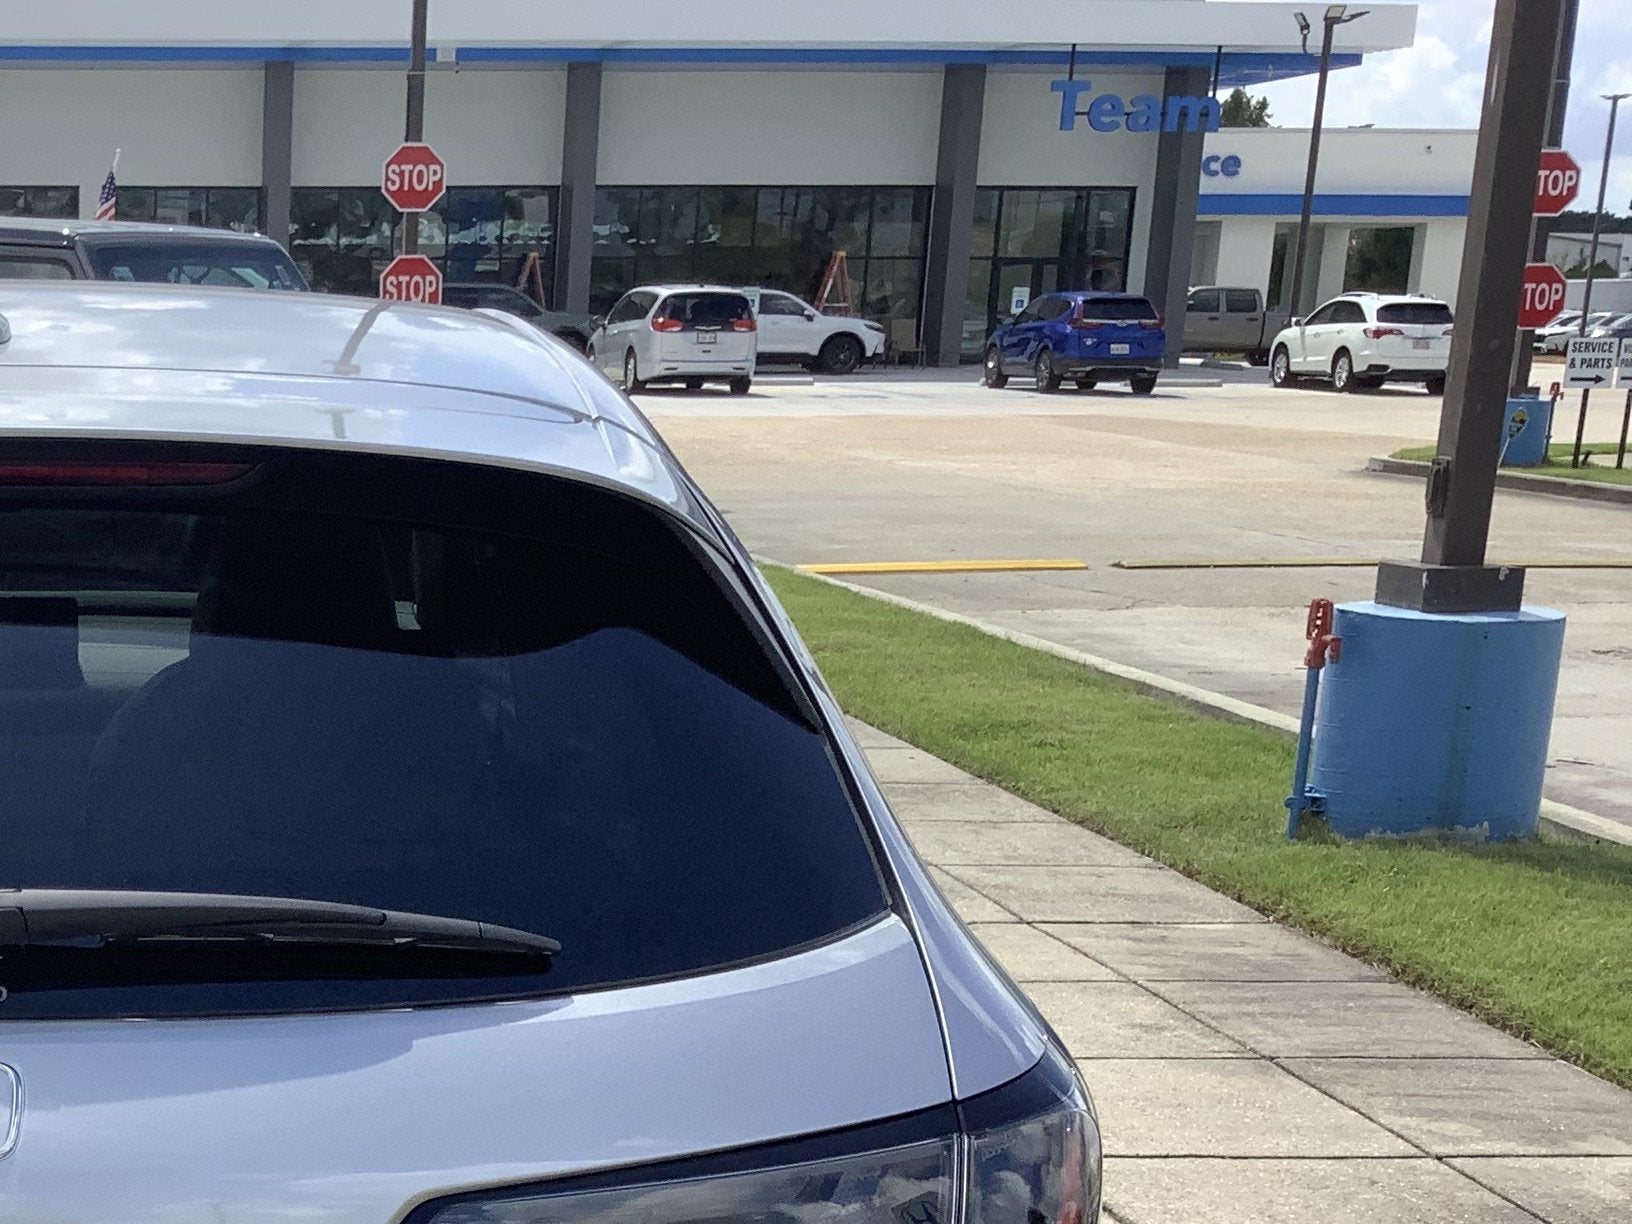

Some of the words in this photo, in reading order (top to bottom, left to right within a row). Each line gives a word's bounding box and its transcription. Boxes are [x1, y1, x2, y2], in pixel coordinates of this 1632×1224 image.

[1050, 79, 1220, 133] Team
[387, 164, 442, 192] STOP
[1202, 154, 1242, 177] ce
[1537, 169, 1578, 196] TOP
[385, 275, 437, 303] STOP
[1524, 282, 1563, 311] TOP
[1571, 341, 1615, 354] SERVICE
[1568, 357, 1576, 369] &
[1579, 357, 1613, 370] PARTS
